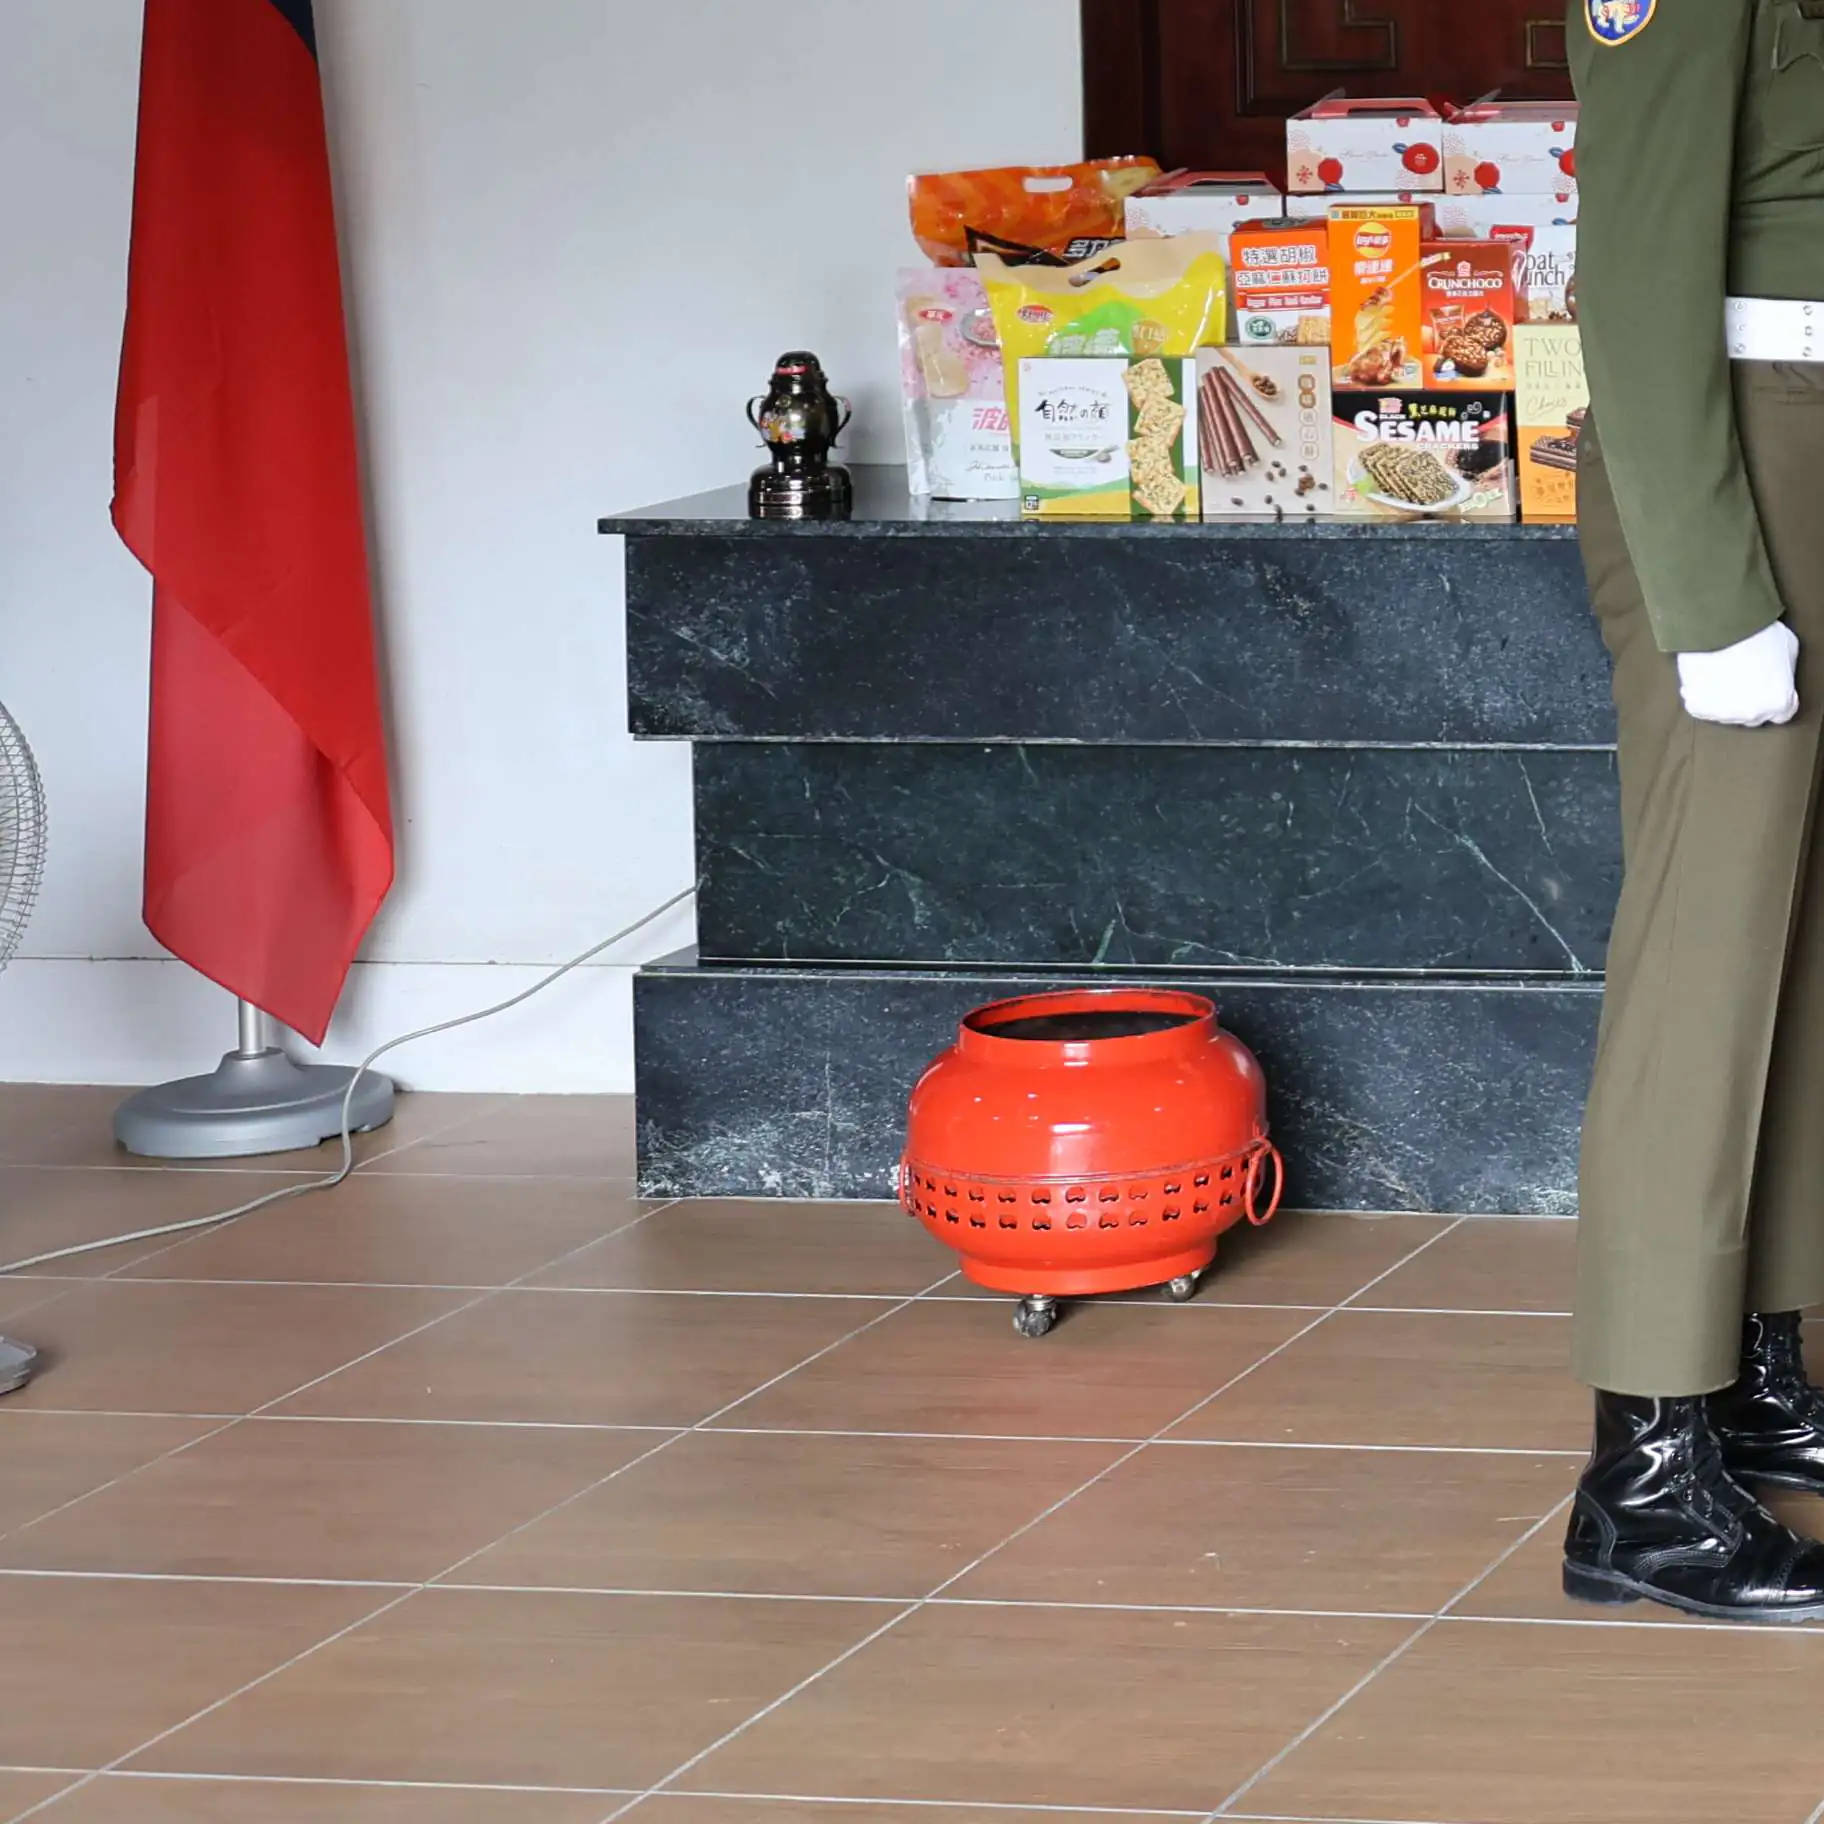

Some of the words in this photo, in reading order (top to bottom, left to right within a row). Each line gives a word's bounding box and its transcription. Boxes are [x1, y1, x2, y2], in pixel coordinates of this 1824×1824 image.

[1428, 277, 1503, 289] CRUNCHOCO
[1524, 338, 1581, 357] TWO
[1525, 360, 1582, 378] FILLIN
[1354, 410, 1479, 443] SESAME
[1416, 442, 1479, 450] CRACKERS
